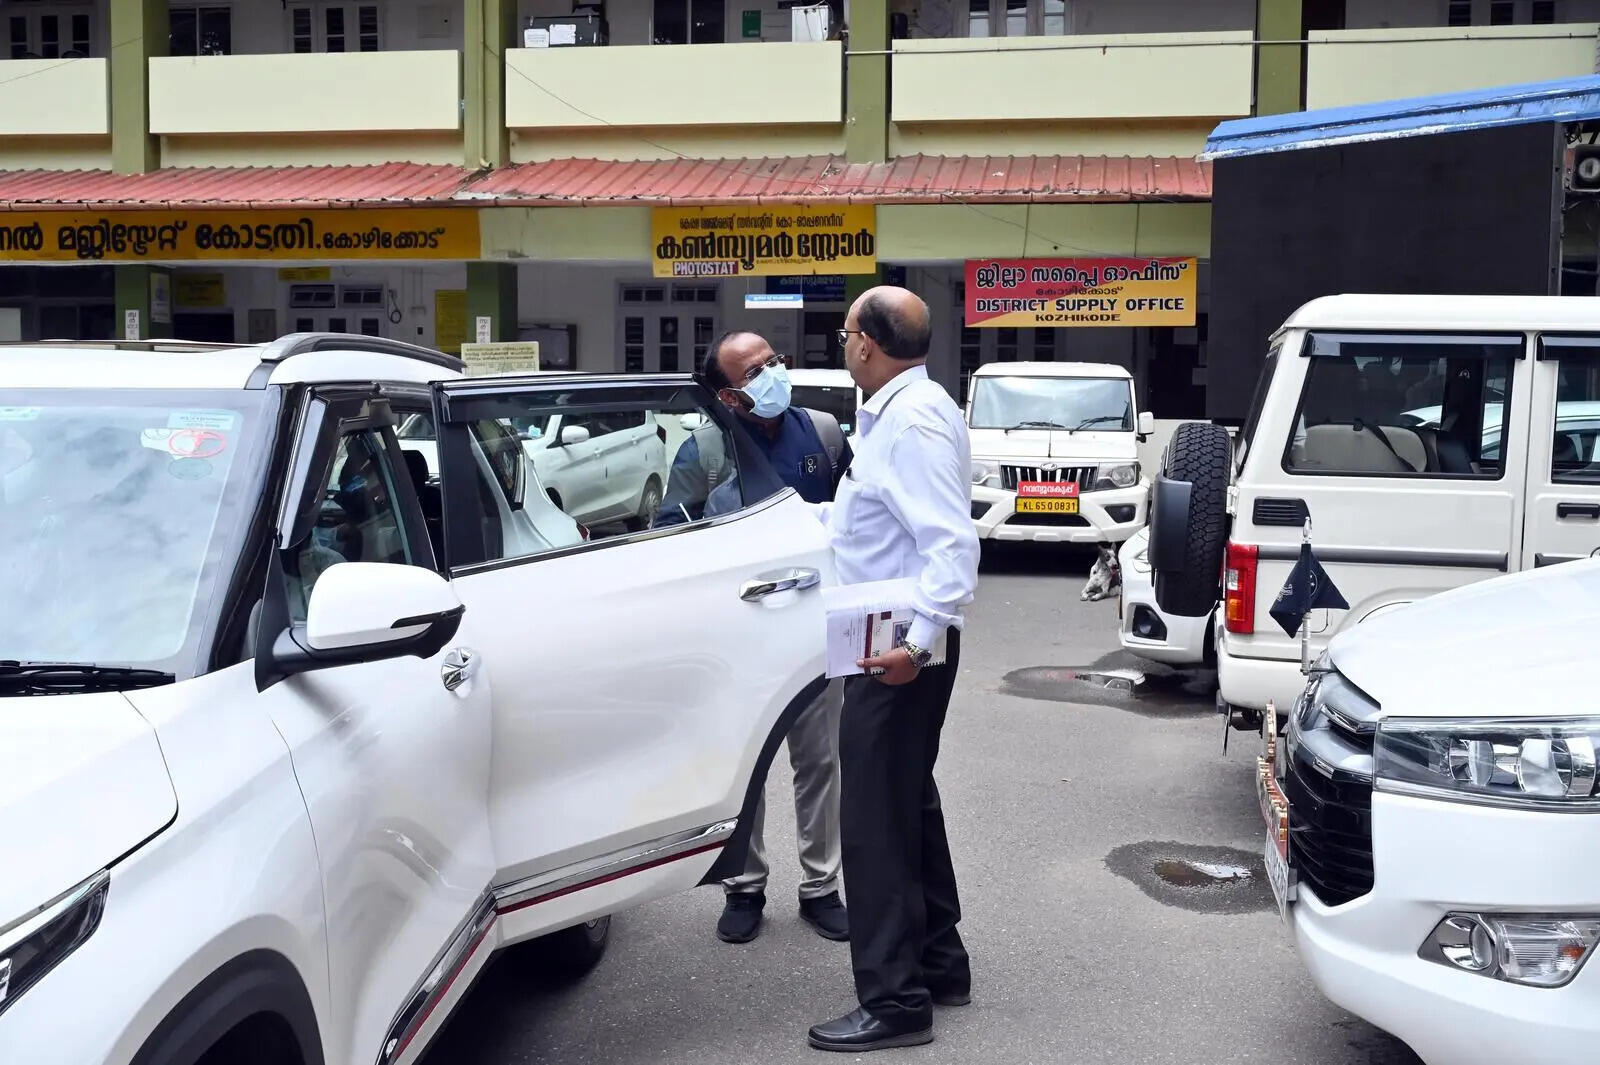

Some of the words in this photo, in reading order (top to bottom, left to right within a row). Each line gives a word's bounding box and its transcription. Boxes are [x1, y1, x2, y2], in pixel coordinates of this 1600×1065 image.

[674, 261, 736, 276] PHOTOSTAT
[976, 298, 1048, 312] DISTRICT
[1056, 298, 1118, 312] SUPPLY
[1125, 297, 1185, 311] OFFICE
[1035, 313, 1121, 322] KOZHIKODE
